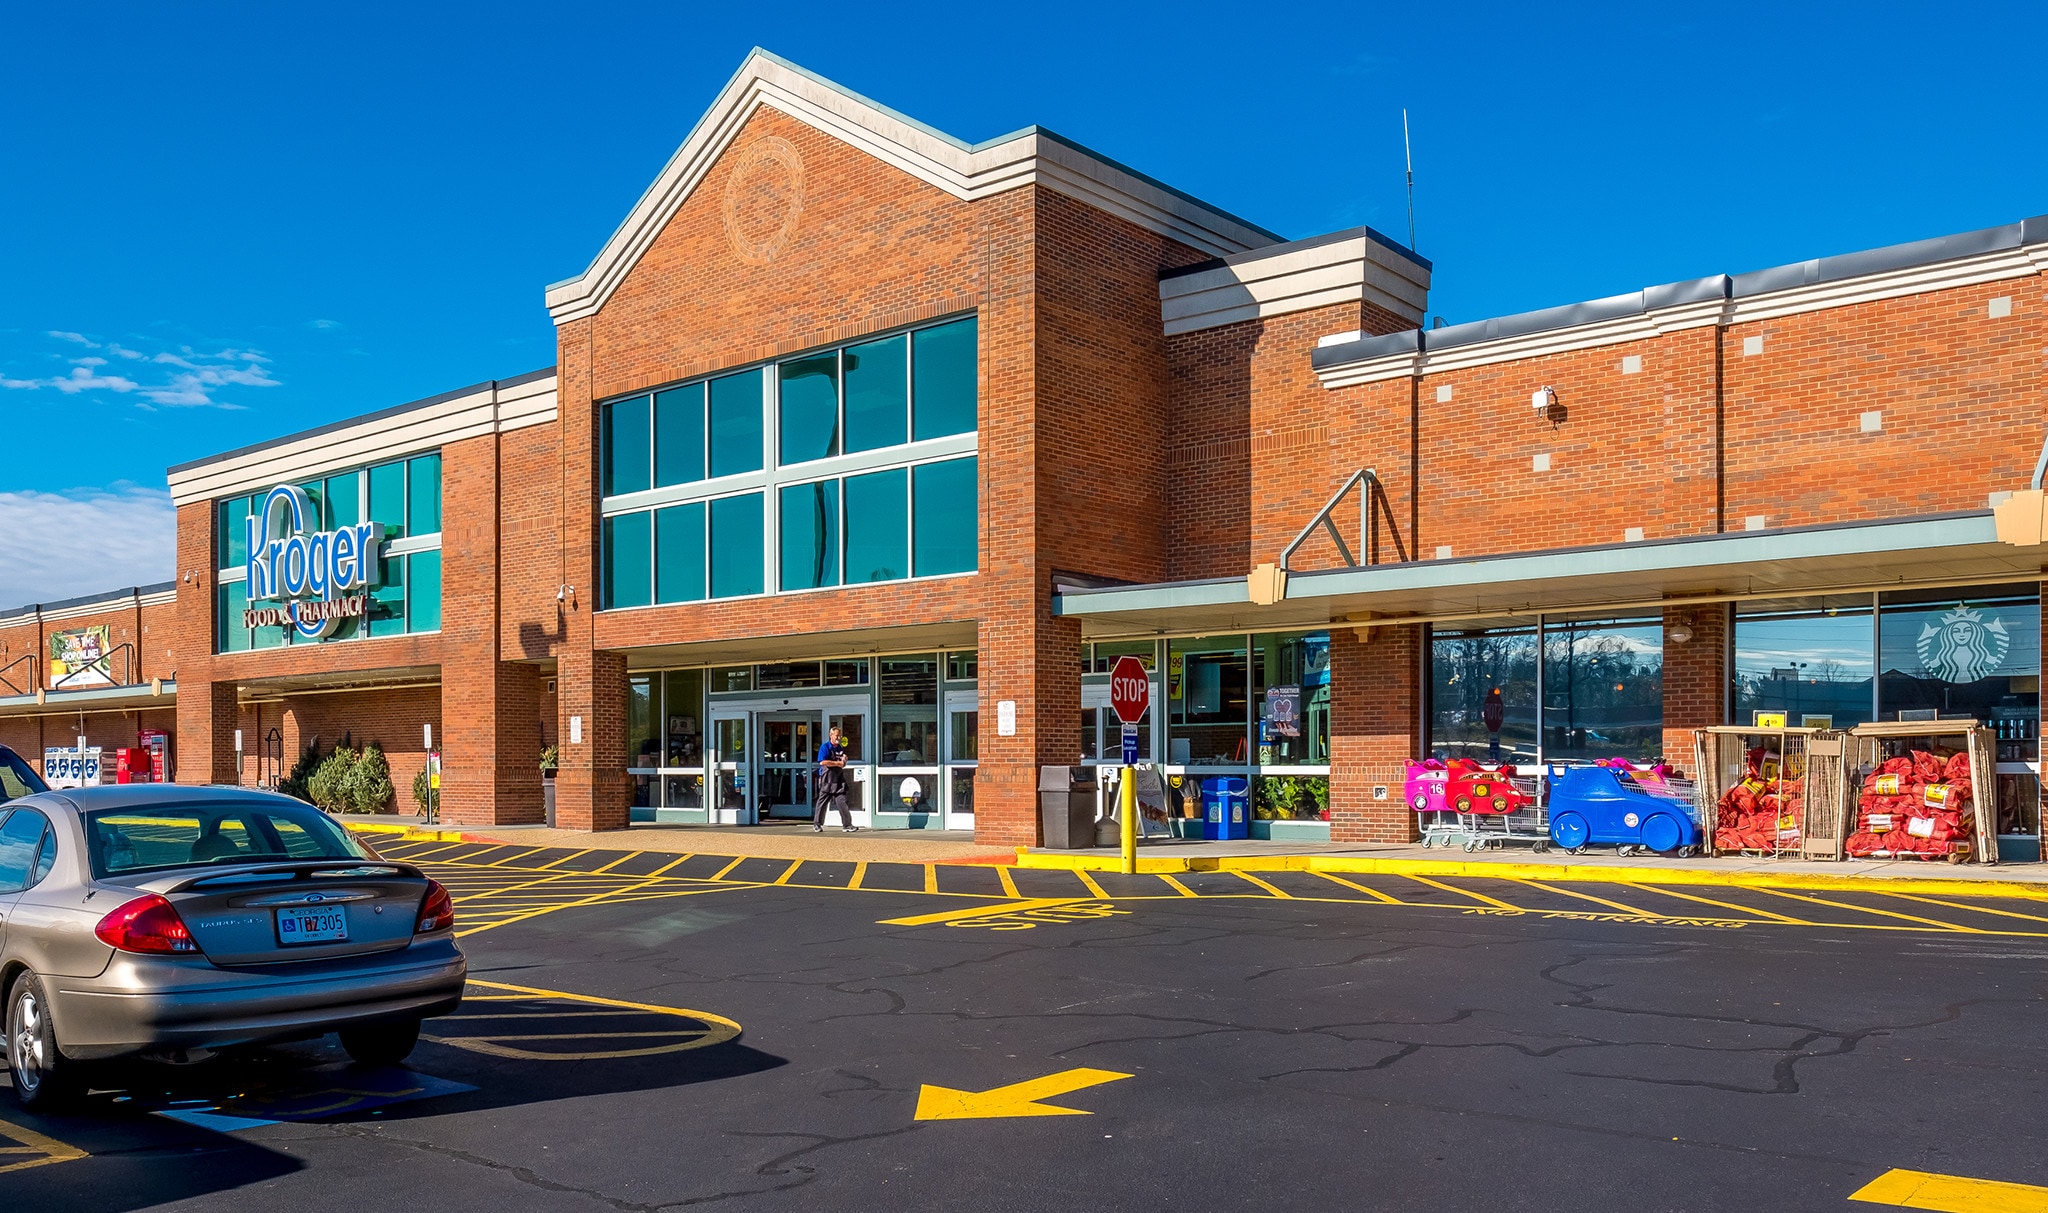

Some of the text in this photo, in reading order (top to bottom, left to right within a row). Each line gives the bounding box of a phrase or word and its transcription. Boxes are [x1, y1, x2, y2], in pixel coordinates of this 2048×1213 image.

[245, 484, 375, 638] Kroger
[243, 595, 367, 628] FOOD & PHARMACY
[65, 637, 80, 650] SAVE
[61, 650, 76, 663] SHOP
[1113, 676, 1147, 702] STOP
[1430, 783, 1443, 792] 16
[293, 907, 329, 916] GEORGIA
[945, 903, 1132, 931] STOP
[1462, 908, 1748, 928] NO PARKING
[296, 914, 343, 933] TBZ305
